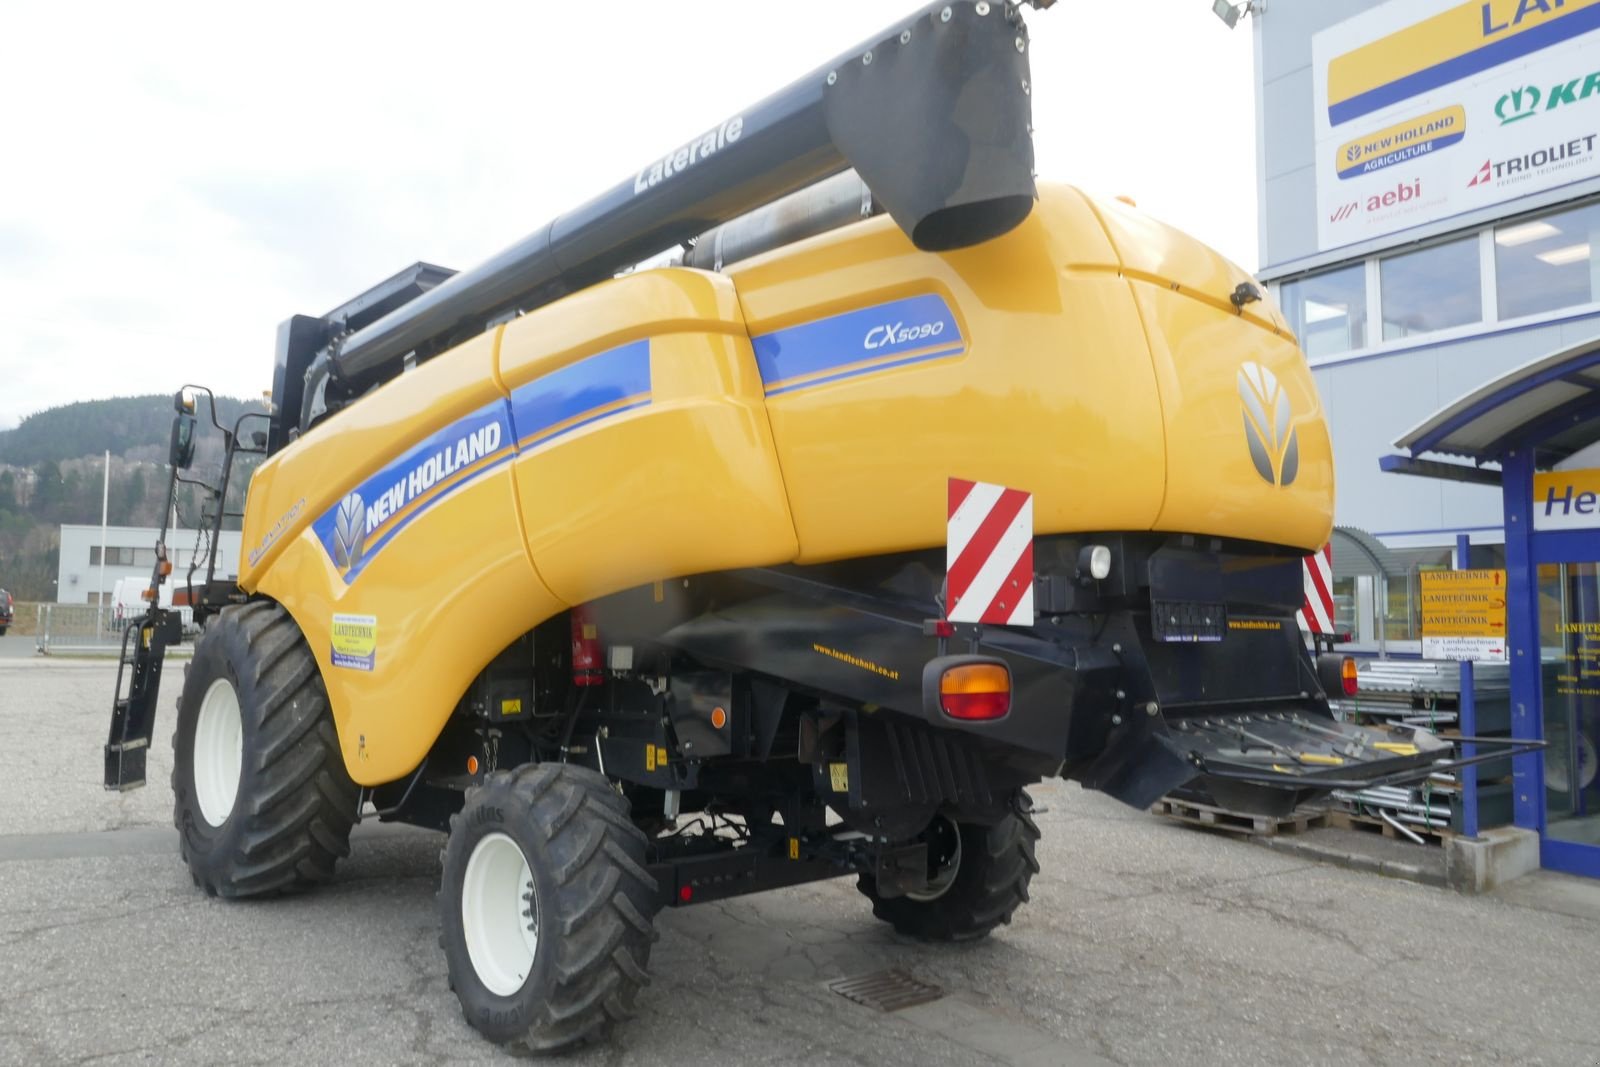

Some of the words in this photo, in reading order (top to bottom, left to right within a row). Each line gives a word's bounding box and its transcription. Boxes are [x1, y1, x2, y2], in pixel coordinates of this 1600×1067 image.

[1481, 0, 1565, 37] LA
[1364, 137, 1392, 154] NEW
[1395, 116, 1455, 144] HOLLAND
[634, 116, 743, 195] Laterale
[1364, 141, 1434, 172] AGRICULTURE
[1493, 133, 1597, 179] TRIOLIET
[1366, 178, 1421, 212] aebi
[864, 320, 944, 349] CX5090
[366, 477, 407, 534] NEW
[408, 421, 501, 500] HOLLAND
[1545, 485, 1600, 517] He
[1424, 571, 1490, 582] LANDTECHNIK
[1423, 594, 1489, 603] LANDTECHNIK
[334, 623, 373, 639] LANDTECHNIK
[1423, 616, 1489, 625] LANDTECHNIK
[813, 643, 899, 680] www.landtechnik.co.at
